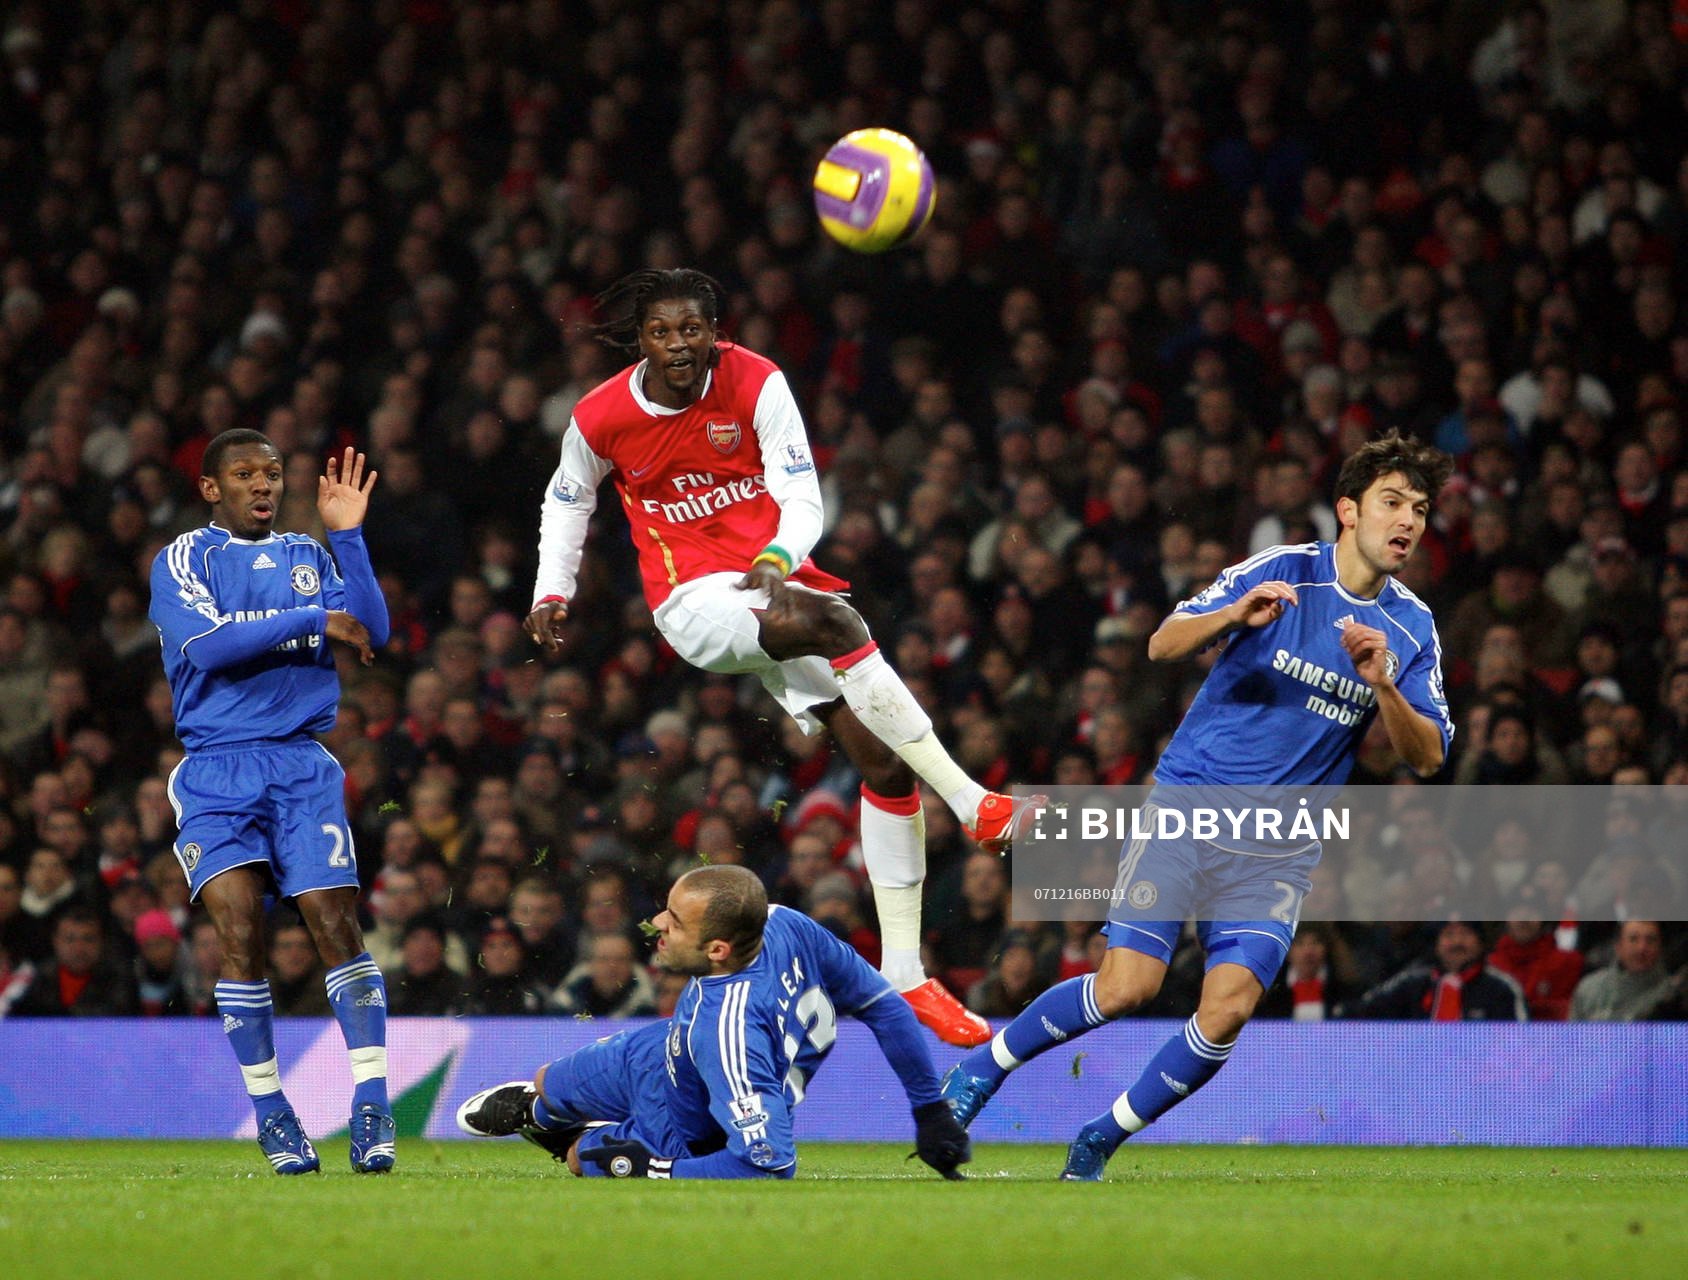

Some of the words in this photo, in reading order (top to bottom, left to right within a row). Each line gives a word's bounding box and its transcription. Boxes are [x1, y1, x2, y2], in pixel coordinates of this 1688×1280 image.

[642, 474, 768, 524] Emirates
[1272, 649, 1377, 709] SAMSUN
[1305, 694, 1366, 727] mobil
[776, 956, 805, 1035] ALEX
